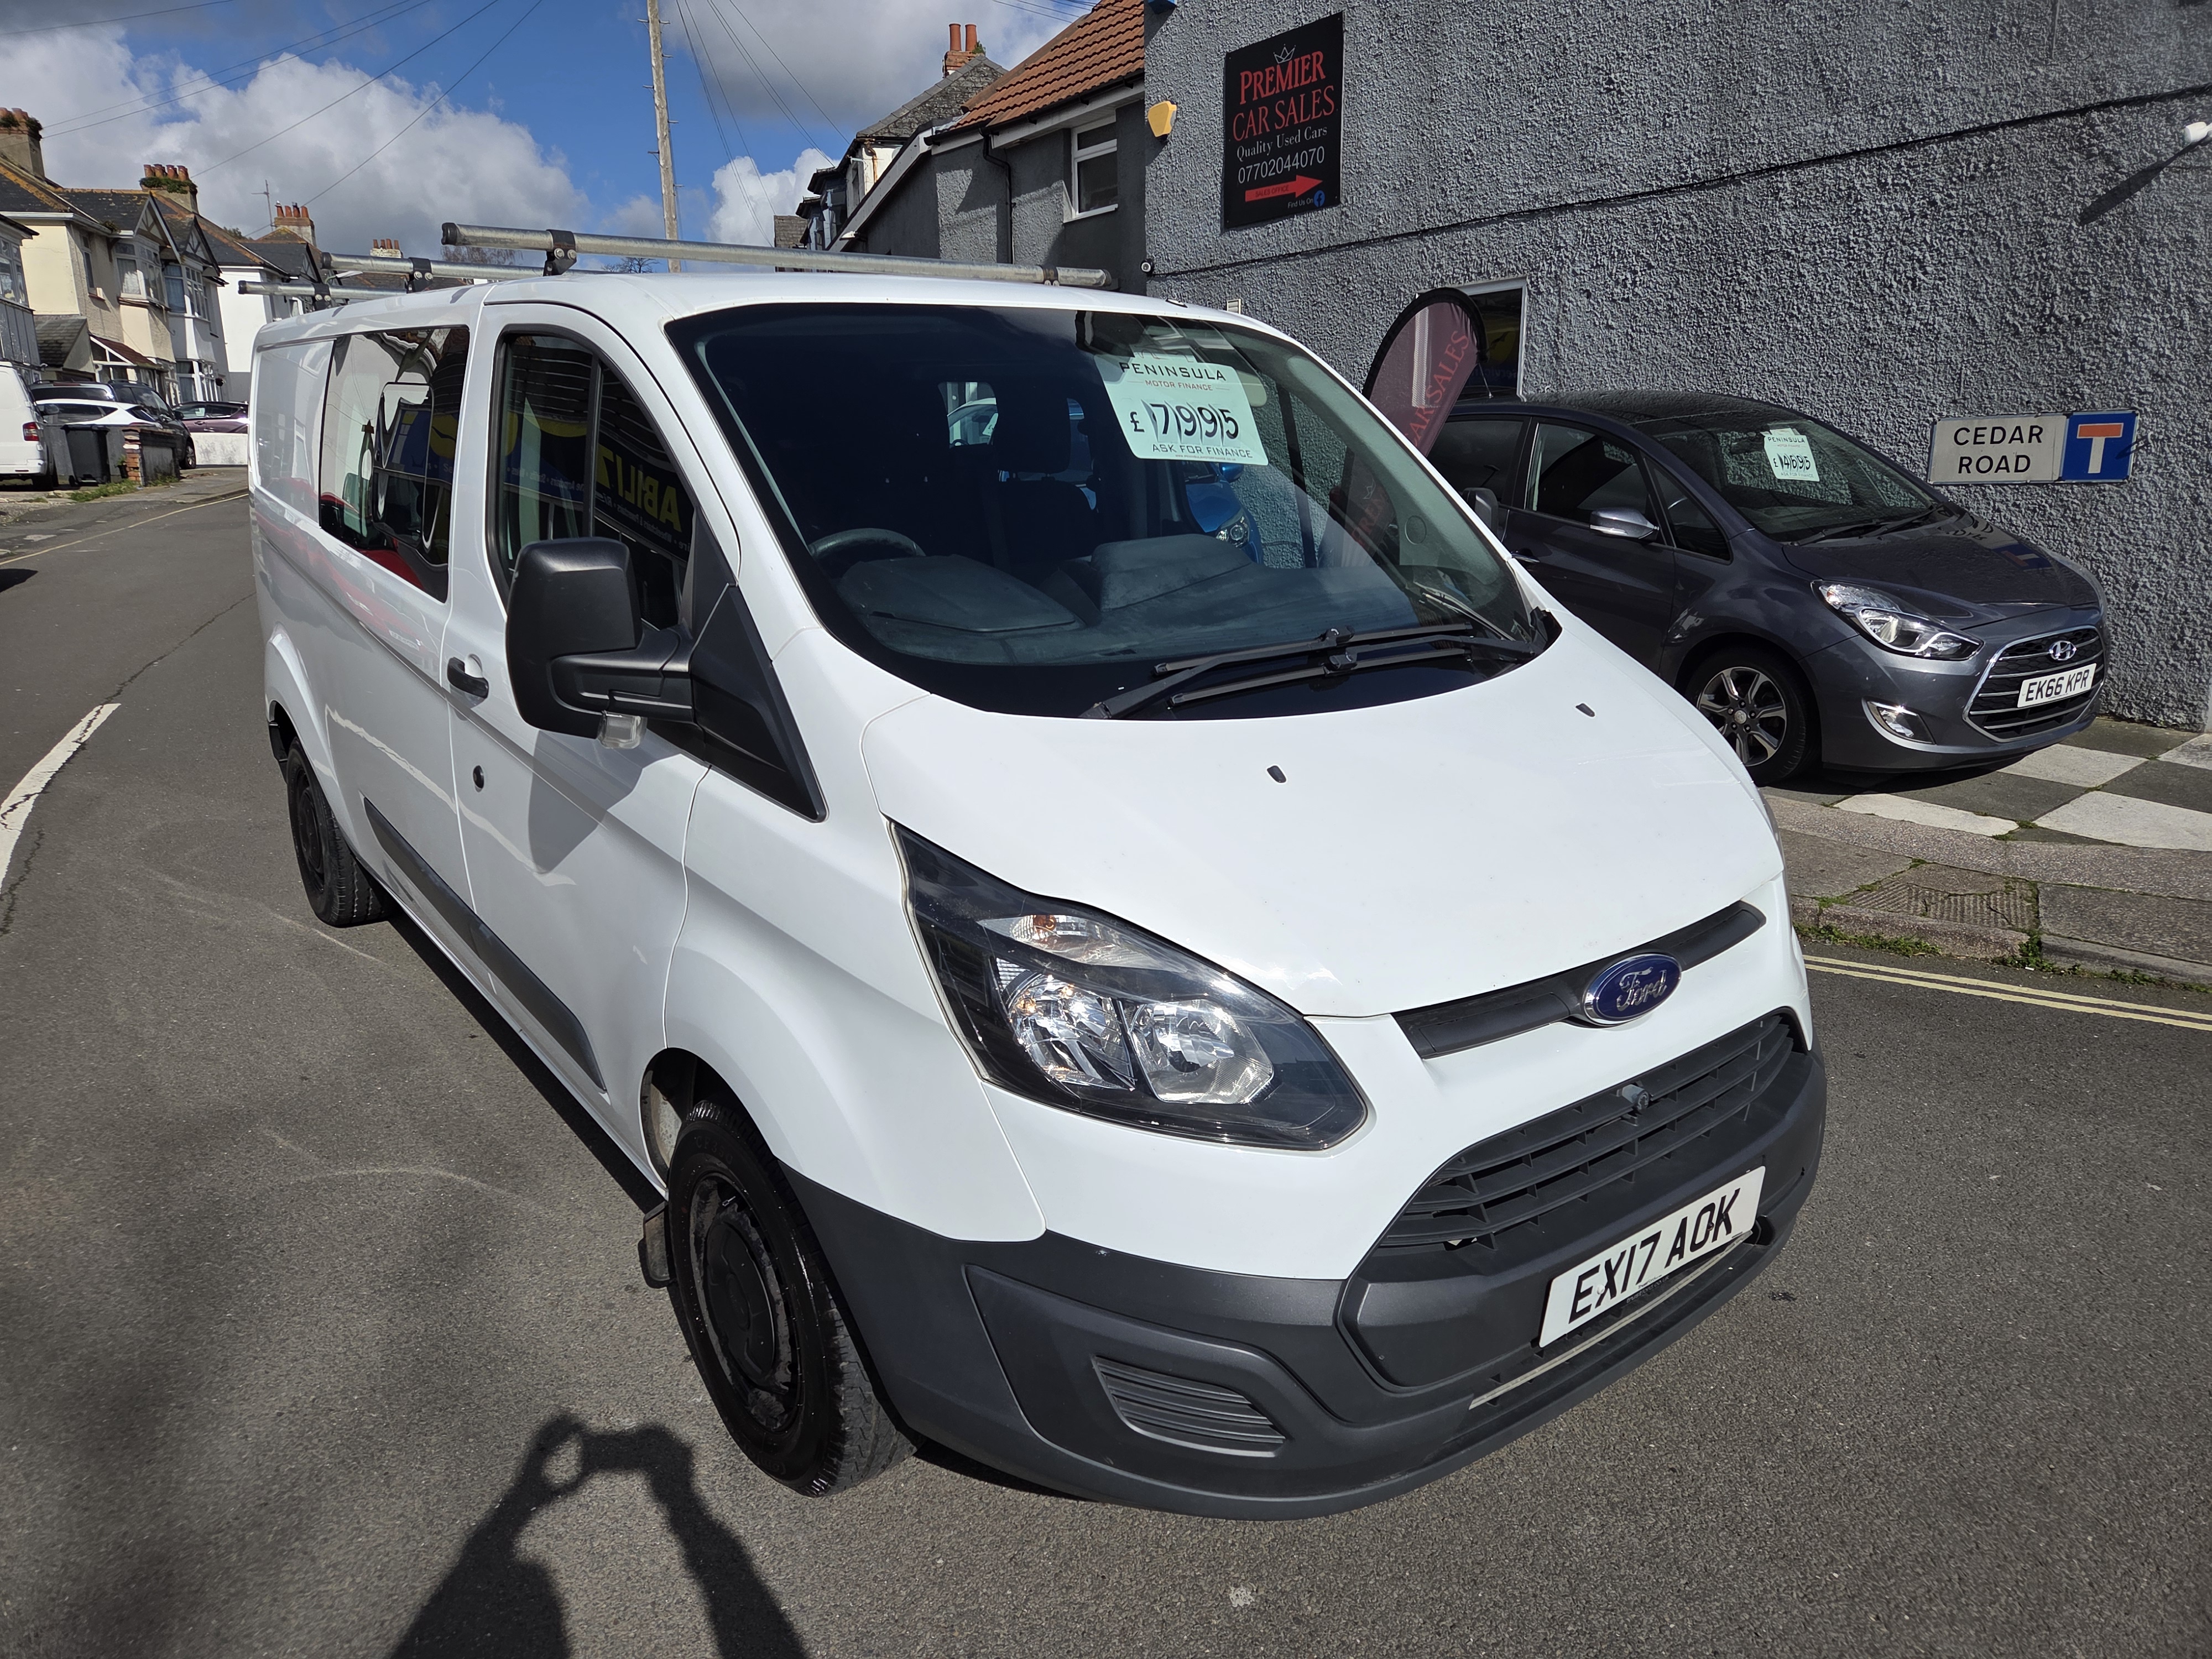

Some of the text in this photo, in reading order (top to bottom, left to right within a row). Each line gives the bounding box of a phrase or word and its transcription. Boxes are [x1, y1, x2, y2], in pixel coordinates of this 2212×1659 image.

[1240, 51, 1326, 105] PREMIER
[1233, 85, 1334, 142] CAR SALES
[1237, 126, 1327, 161] Quality Used Cars
[1238, 146, 1324, 184] 07702044070
[1255, 189, 1271, 197] SALES
[1119, 362, 1226, 381] PENINSULA
[1426, 330, 1469, 404] SALES
[1145, 379, 1213, 391] MOTOR FINANCE
[1130, 403, 1239, 439] £ 7995
[1954, 425, 2043, 446] CEDAR
[1152, 444, 1253, 458] ASK FOR FINANCE
[1783, 455, 1811, 470] 4695
[1958, 454, 2031, 474] ROAD
[2025, 669, 2090, 702] EK66 KPR
[1616, 966, 1667, 1012] Ford
[1568, 1188, 1741, 1324] EX17 AOK
